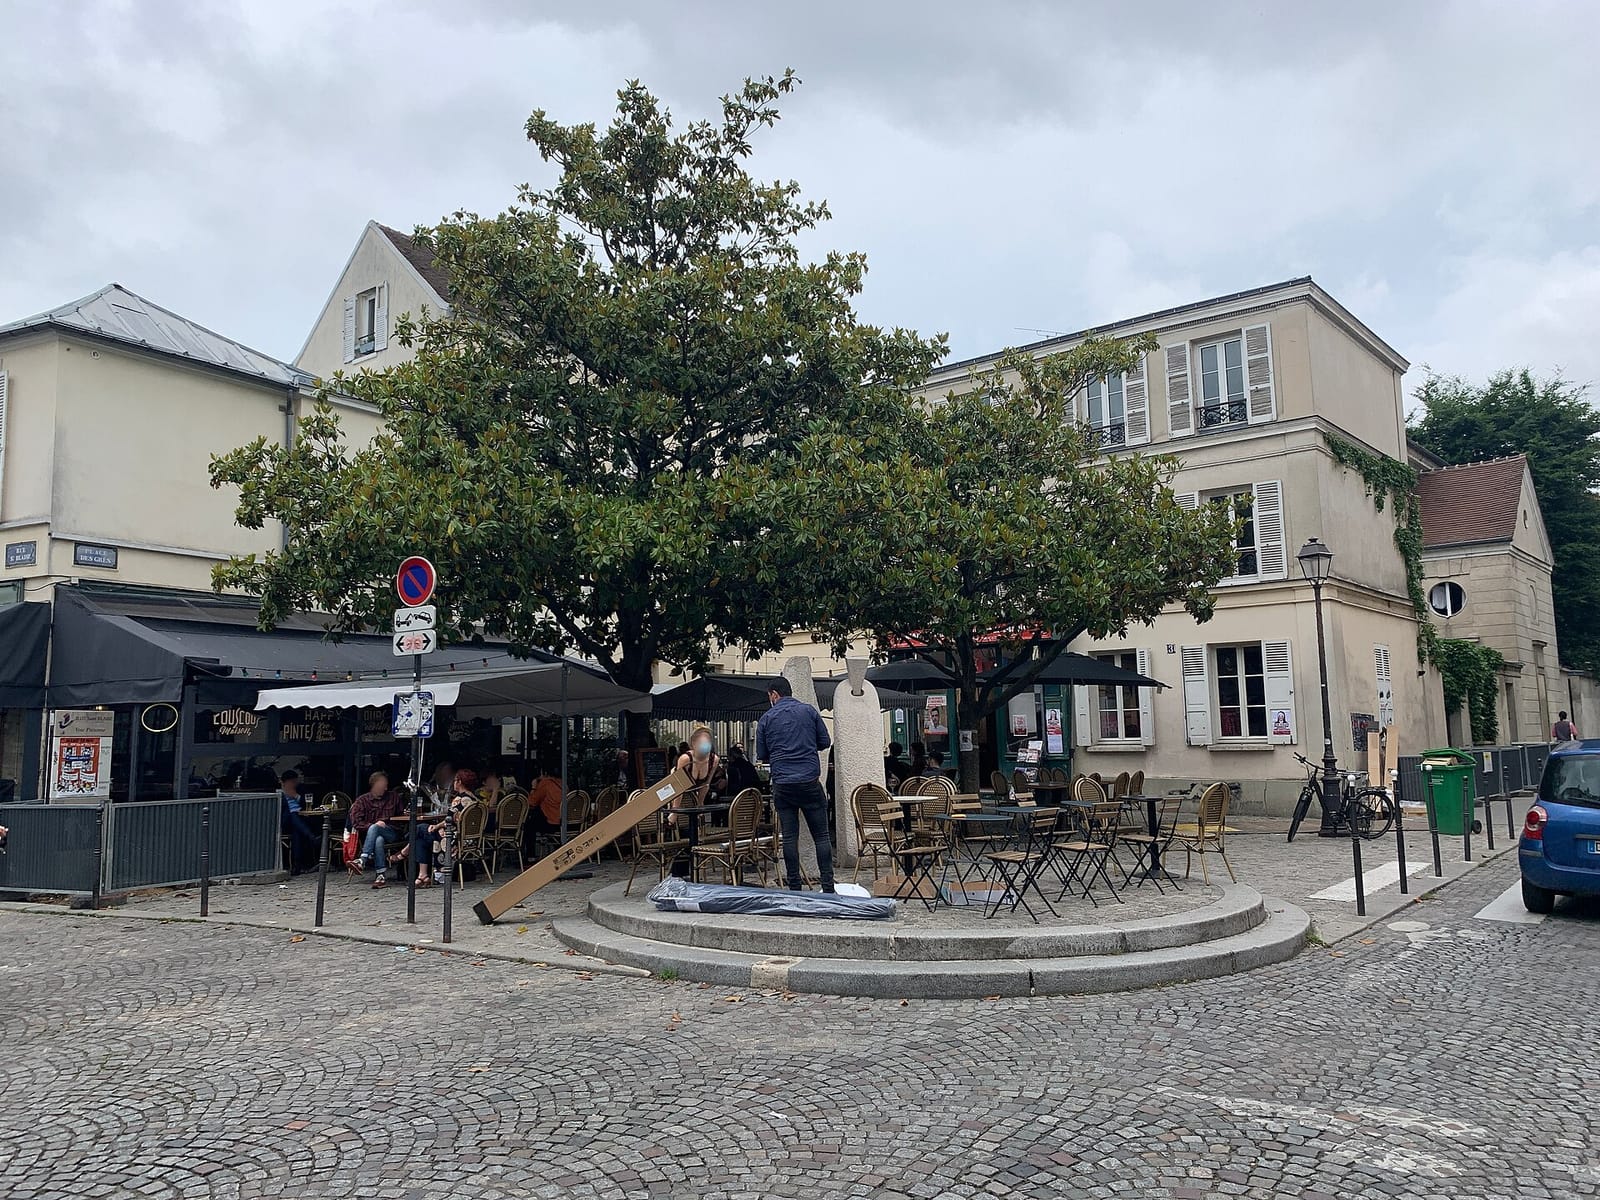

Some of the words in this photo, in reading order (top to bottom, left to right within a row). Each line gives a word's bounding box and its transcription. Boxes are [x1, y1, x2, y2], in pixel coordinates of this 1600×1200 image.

[84, 548, 106, 556] PLACE
[80, 554, 93, 562] DES
[213, 707, 260, 729] COUSCOUS
[304, 710, 342, 721] HAPPY
[219, 726, 252, 737] Maison
[283, 722, 315, 742] PINTES
